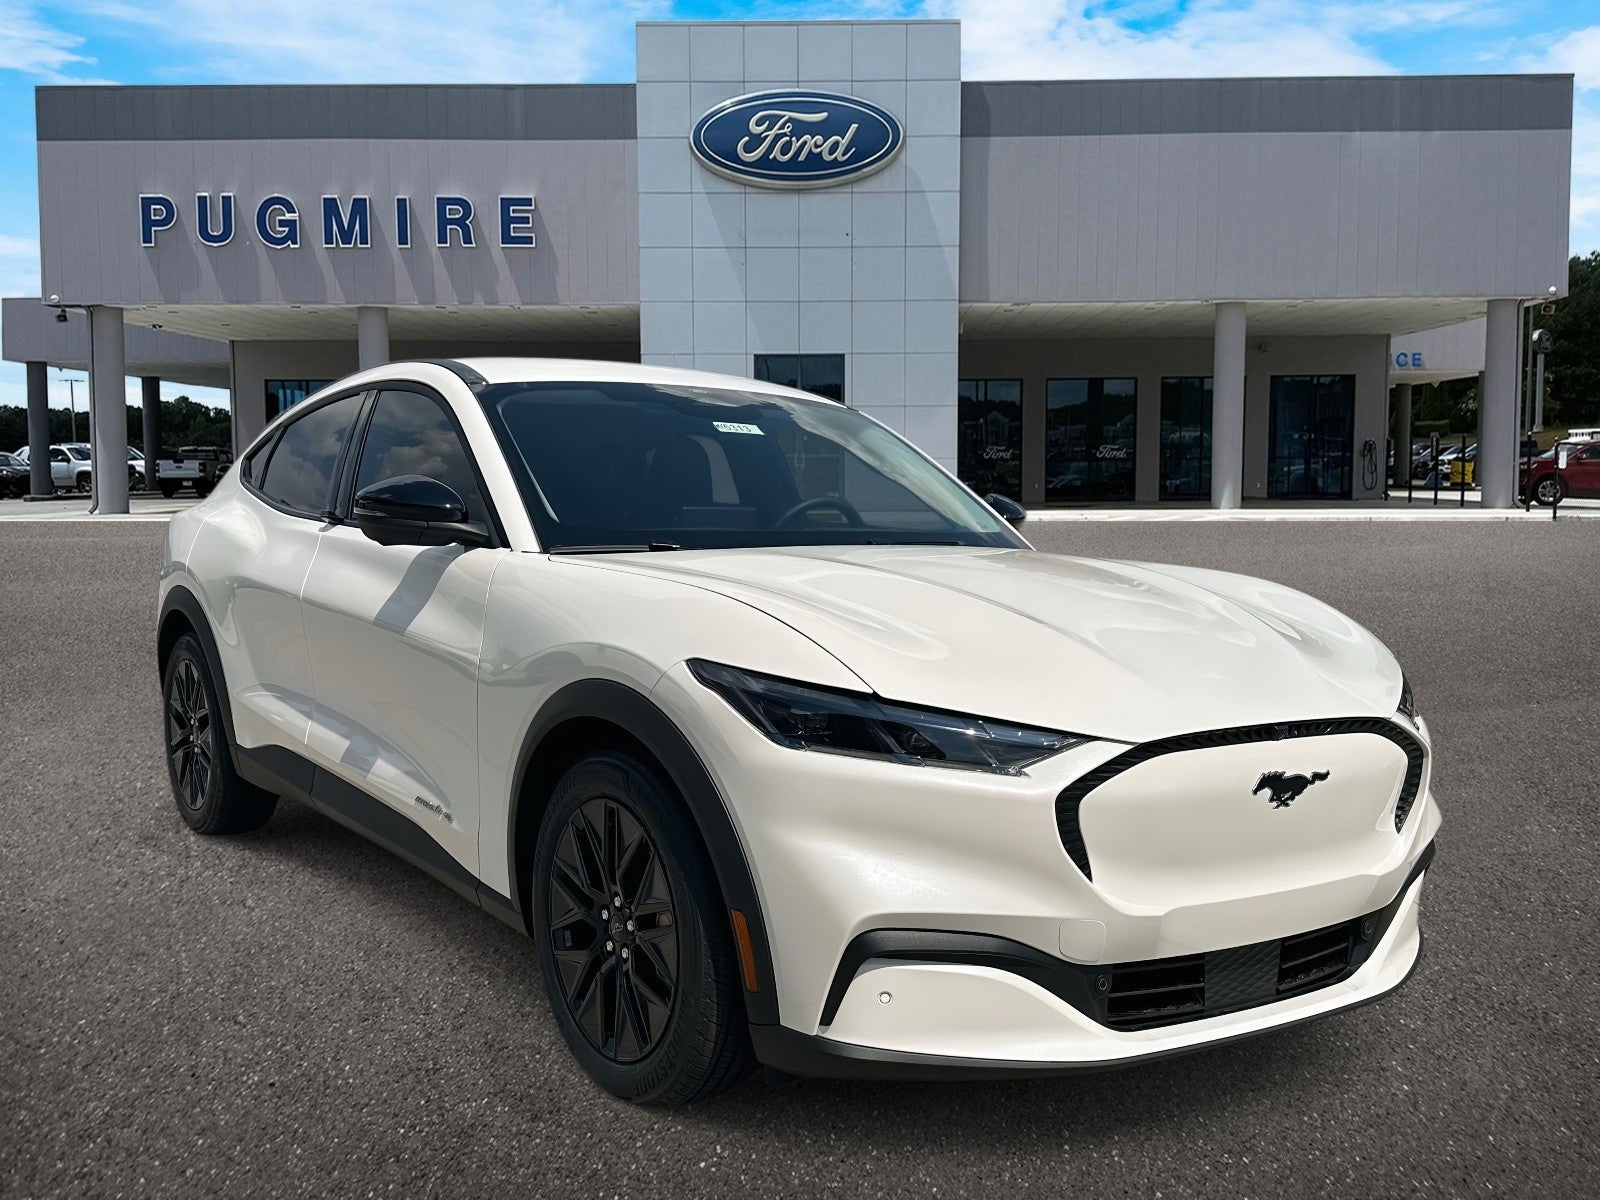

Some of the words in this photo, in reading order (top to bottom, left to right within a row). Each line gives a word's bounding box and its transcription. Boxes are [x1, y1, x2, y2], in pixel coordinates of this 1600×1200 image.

[737, 110, 859, 163] Ford
[138, 192, 536, 250] PUGMIRE
[983, 446, 1013, 460] Ford
[1096, 445, 1127, 459] Ford
